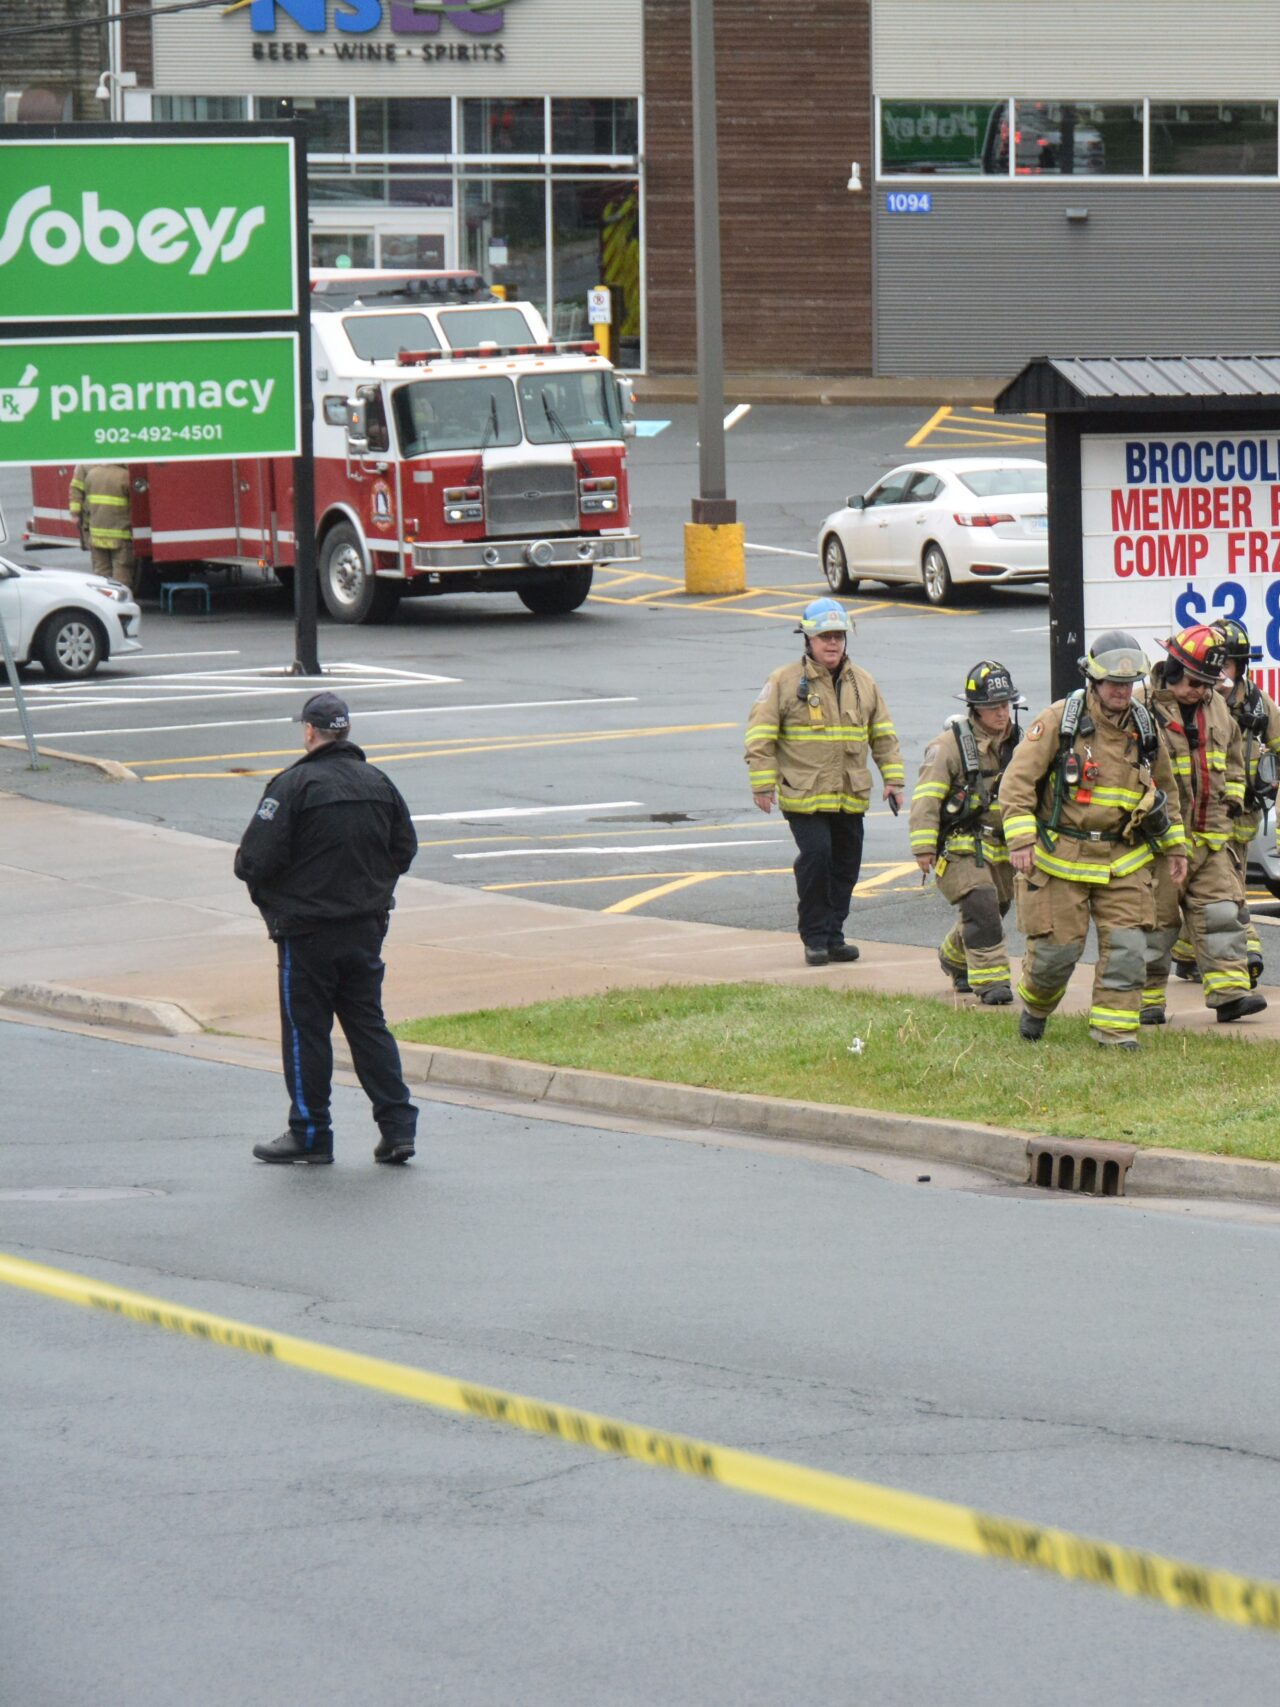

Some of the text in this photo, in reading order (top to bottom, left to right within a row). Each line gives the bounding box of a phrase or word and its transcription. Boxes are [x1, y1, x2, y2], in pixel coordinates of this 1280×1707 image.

[252, 42, 506, 62] BEER WINE SPIRITS
[887, 193, 930, 212] 1094
[0, 185, 266, 276] Sobeys
[50, 374, 275, 421] pharmacy
[94, 424, 223, 444] 902-492-4501
[1111, 486, 1253, 532] MEMBER
[1113, 534, 1209, 578] COMP
[987, 675, 1010, 691] 286
[1067, 699, 1080, 724] MSA
